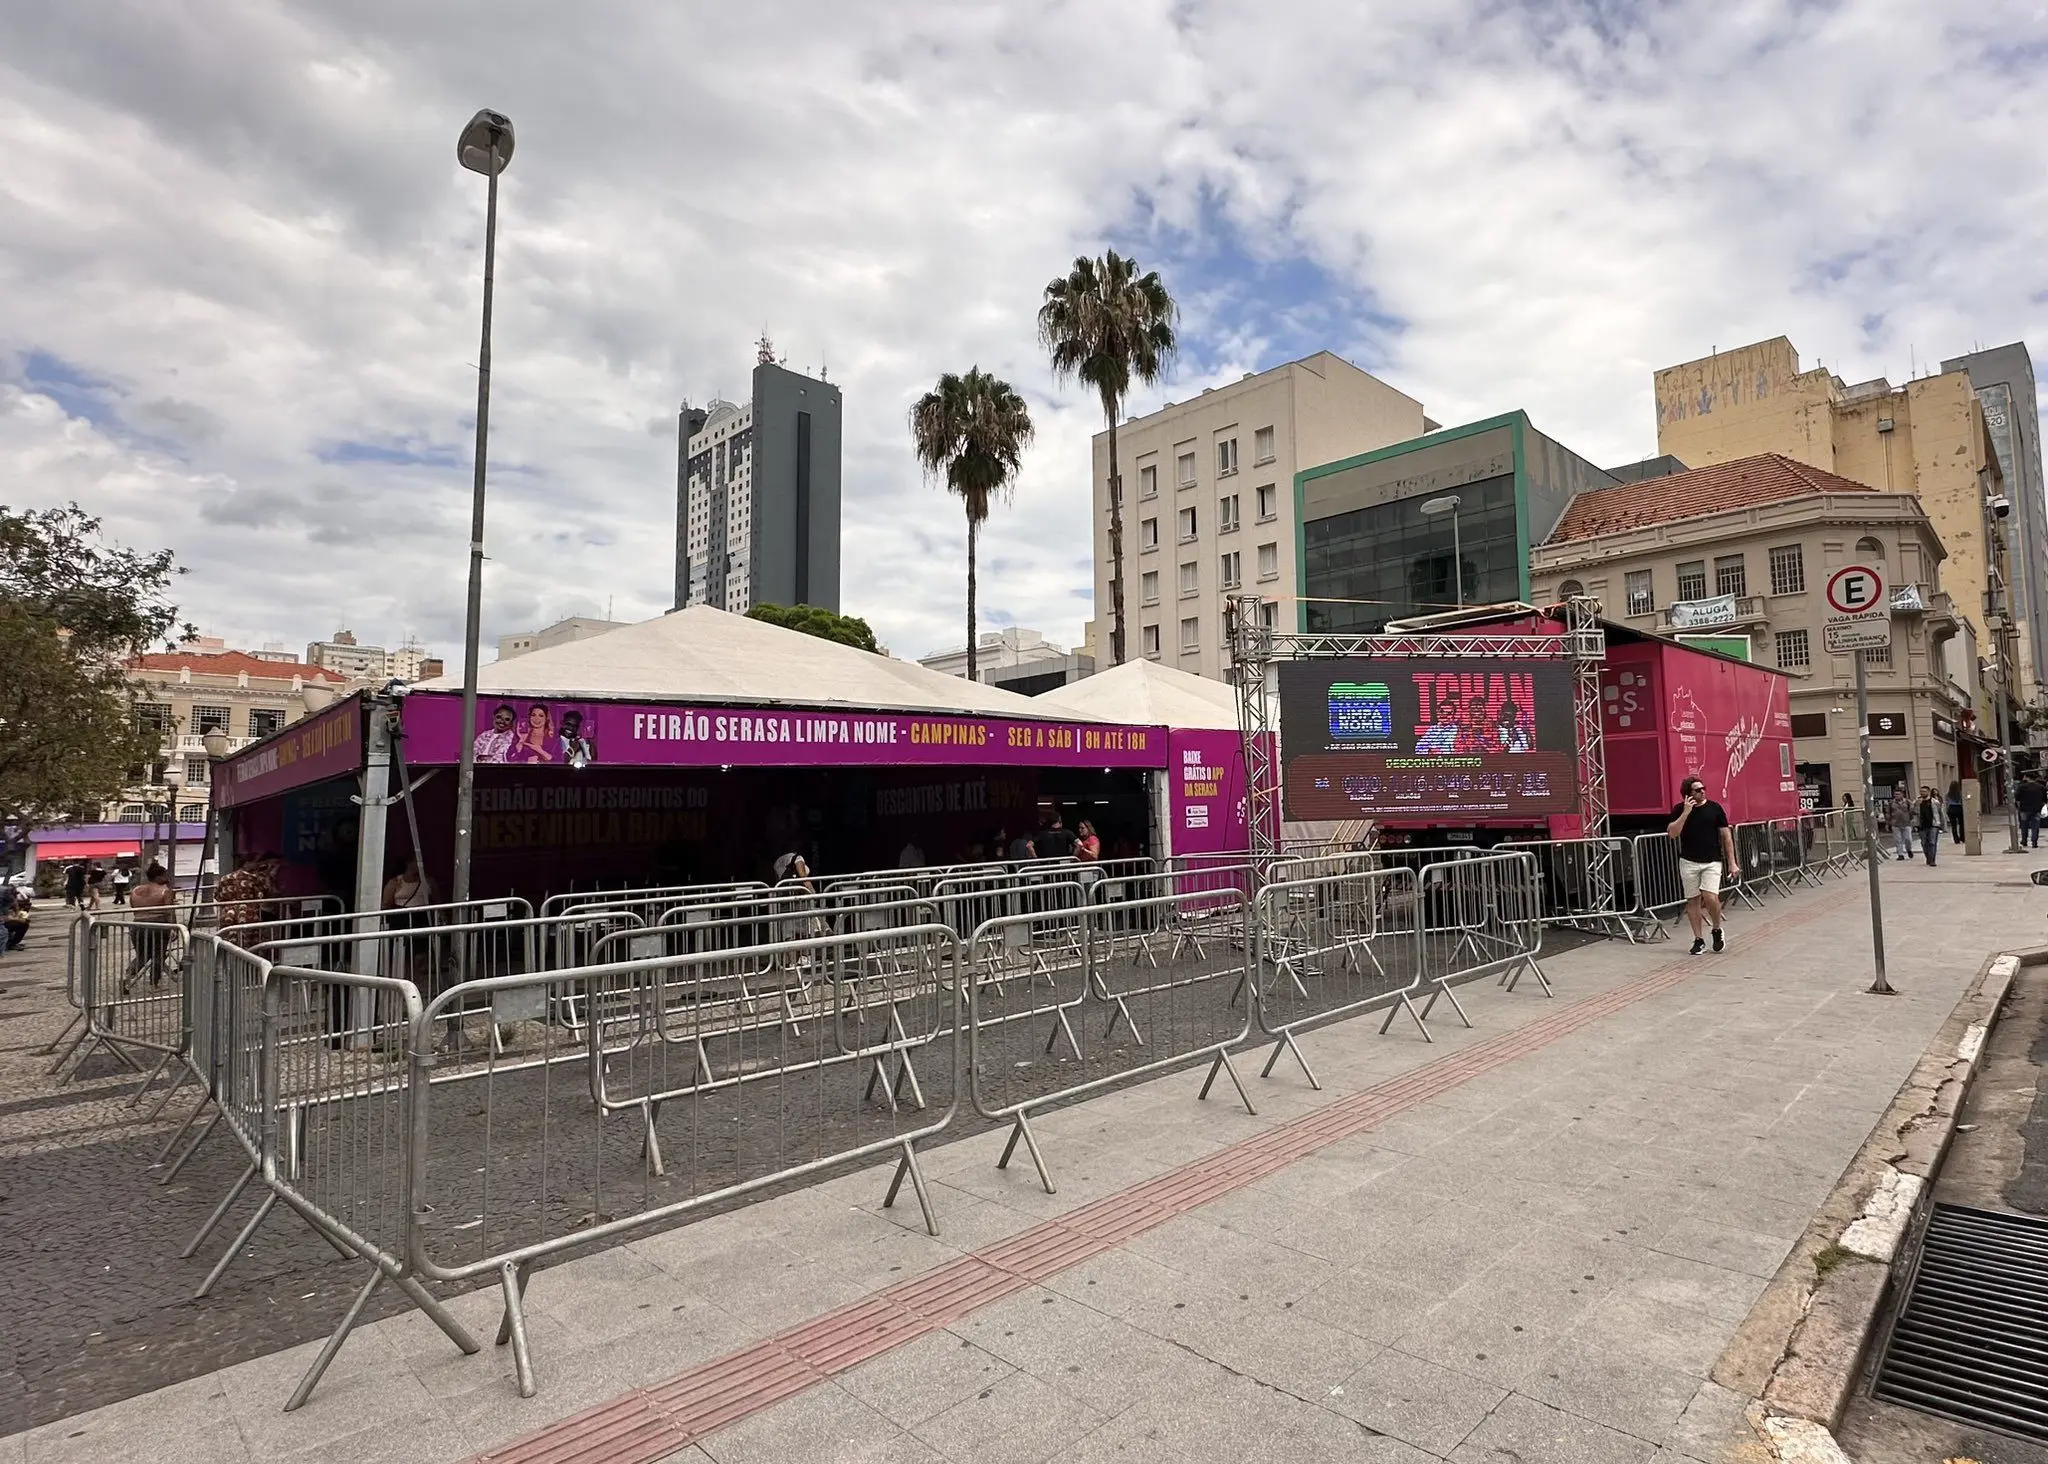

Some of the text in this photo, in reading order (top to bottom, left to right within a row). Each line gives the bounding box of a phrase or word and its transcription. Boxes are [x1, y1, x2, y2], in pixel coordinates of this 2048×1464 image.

[1844, 575, 1865, 604] E
[1692, 604, 1729, 616] ALUGA
[1827, 611, 1884, 623] VAGA RÁPIDA
[1828, 631, 1839, 639] 15
[1858, 634, 1888, 642] BRANCA
[1338, 708, 1383, 720] LIMPA
[634, 710, 710, 742] FEIRÃO
[715, 715, 790, 743] SERASA
[795, 720, 850, 744] LIMPA
[853, 721, 898, 744] NOME
[910, 723, 987, 746] CAMPINAS
[1008, 726, 1031, 747] SEG
[1035, 727, 1045, 747] A
[1048, 725, 1072, 748] SÁB
[1085, 730, 1101, 750] 8H
[1104, 728, 1124, 751] ATÉ
[1126, 731, 1147, 751] 18H
[1338, 719, 1383, 731] NOME
[1183, 750, 1202, 764] BAIXE
[1385, 755, 1482, 769] DESCONTÔMETRO
[1183, 764, 1225, 781] GRÁTIS O APP
[587, 785, 681, 808] DESCONTOS
[1184, 782, 1218, 797] DA SERASA
[876, 785, 943, 818] DESCONTOS
[945, 783, 962, 812] DE
[962, 776, 987, 811] ATÉ
